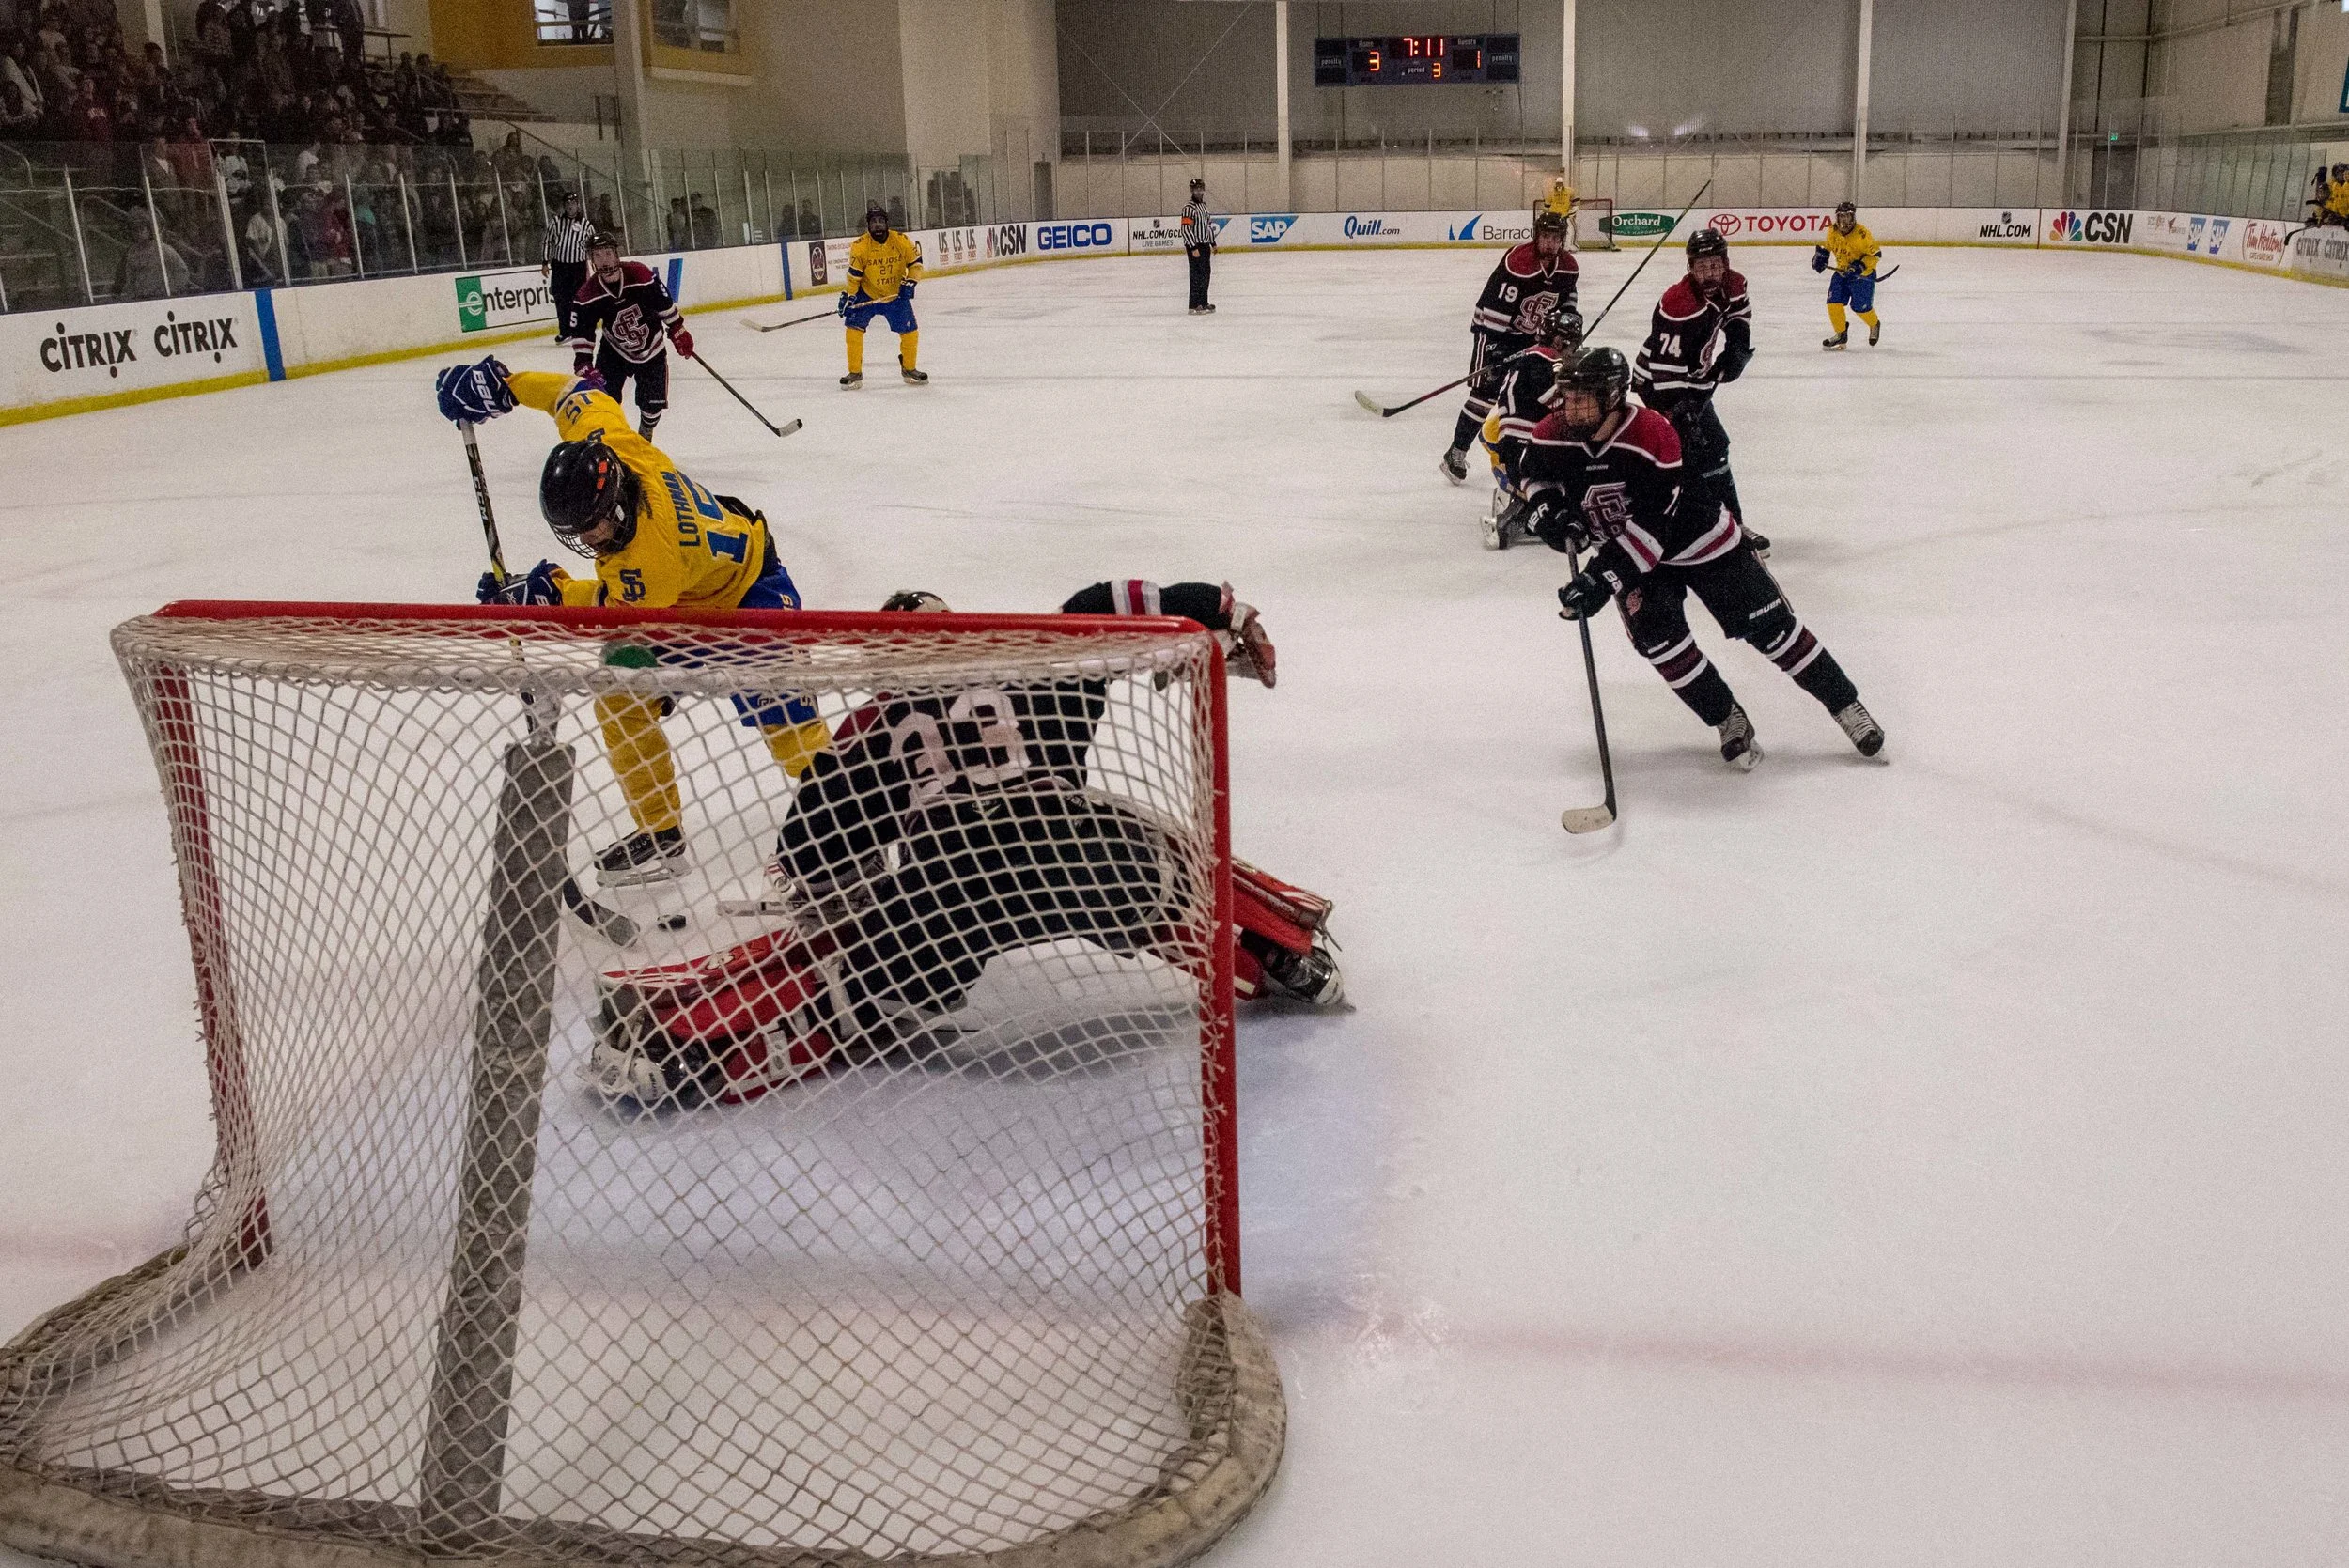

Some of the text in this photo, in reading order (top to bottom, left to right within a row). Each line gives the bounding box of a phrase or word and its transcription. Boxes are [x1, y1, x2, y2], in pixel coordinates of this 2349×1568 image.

[1403, 38, 1444, 56] 7:11
[1369, 51, 1380, 71] 3
[1432, 62, 1441, 77] 3
[1252, 221, 1288, 239] SAP
[1344, 215, 1400, 239] Quill.com
[1611, 215, 1661, 226] Orchard
[1745, 215, 1833, 232] TOYOTA
[2085, 212, 2133, 244] CSN
[1000, 224, 1027, 256] CSN
[1038, 223, 1112, 251] GEICO
[1483, 225, 1535, 241] Barracu
[1979, 224, 2031, 238] NHL.COM
[1498, 283, 1519, 303] 19
[569, 311, 578, 328] 5
[154, 311, 239, 364] CITRIX
[1660, 333, 1682, 357] 74
[40, 322, 137, 378] CITRIX
[661, 471, 701, 547] LOTHMAN
[675, 469, 749, 564] 15
